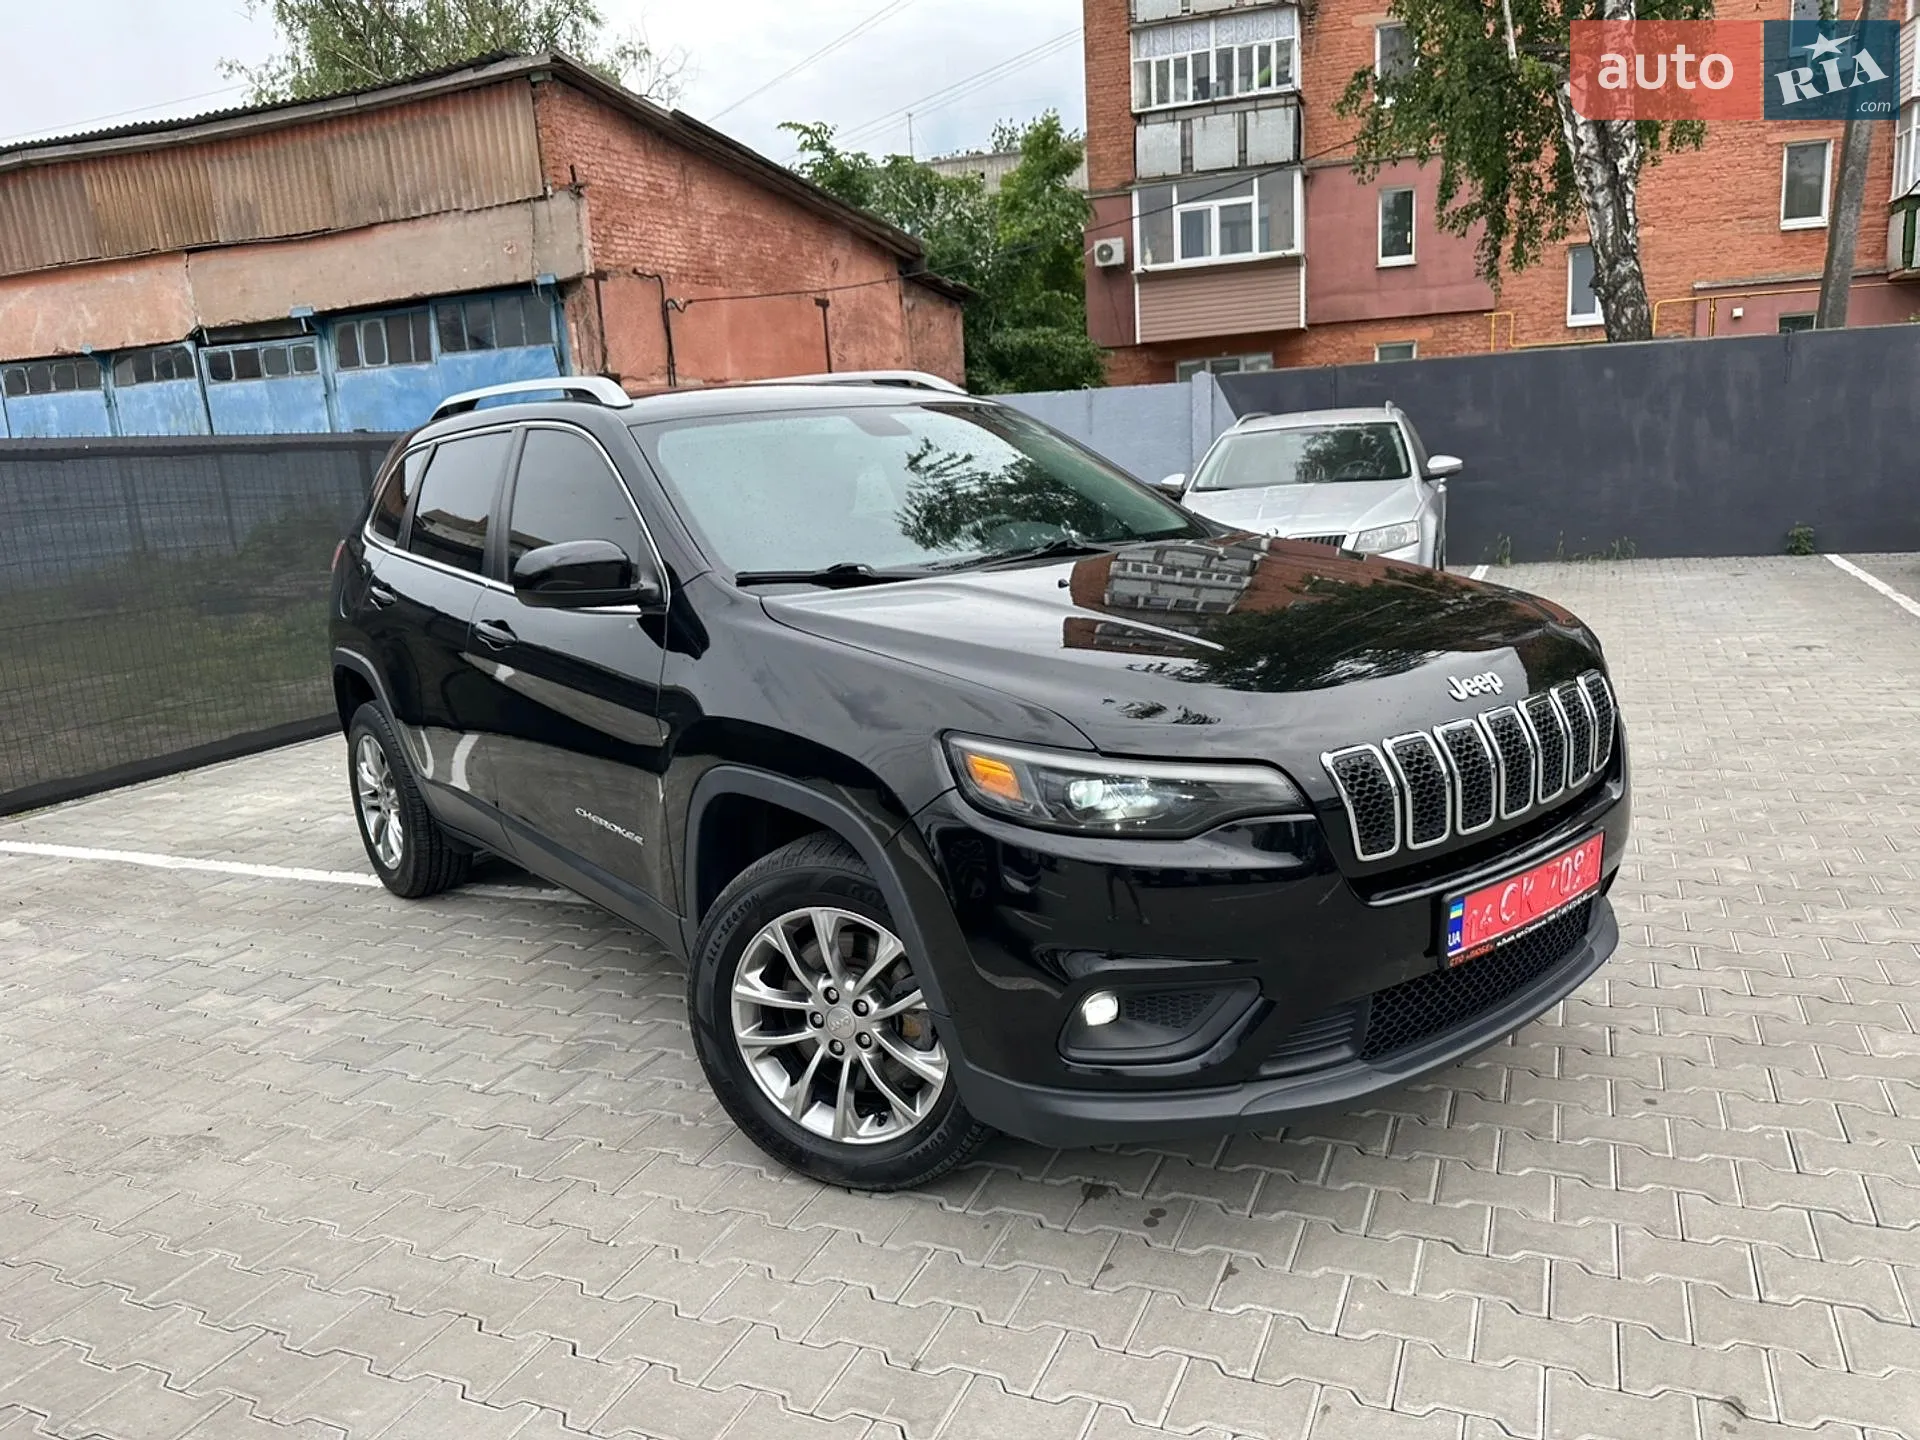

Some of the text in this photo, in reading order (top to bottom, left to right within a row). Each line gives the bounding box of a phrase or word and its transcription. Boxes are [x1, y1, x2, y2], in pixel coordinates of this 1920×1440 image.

[1447, 671, 1504, 702] Jeep
[574, 807, 645, 846] CHEROKEE
[1448, 930, 1461, 947] UA
